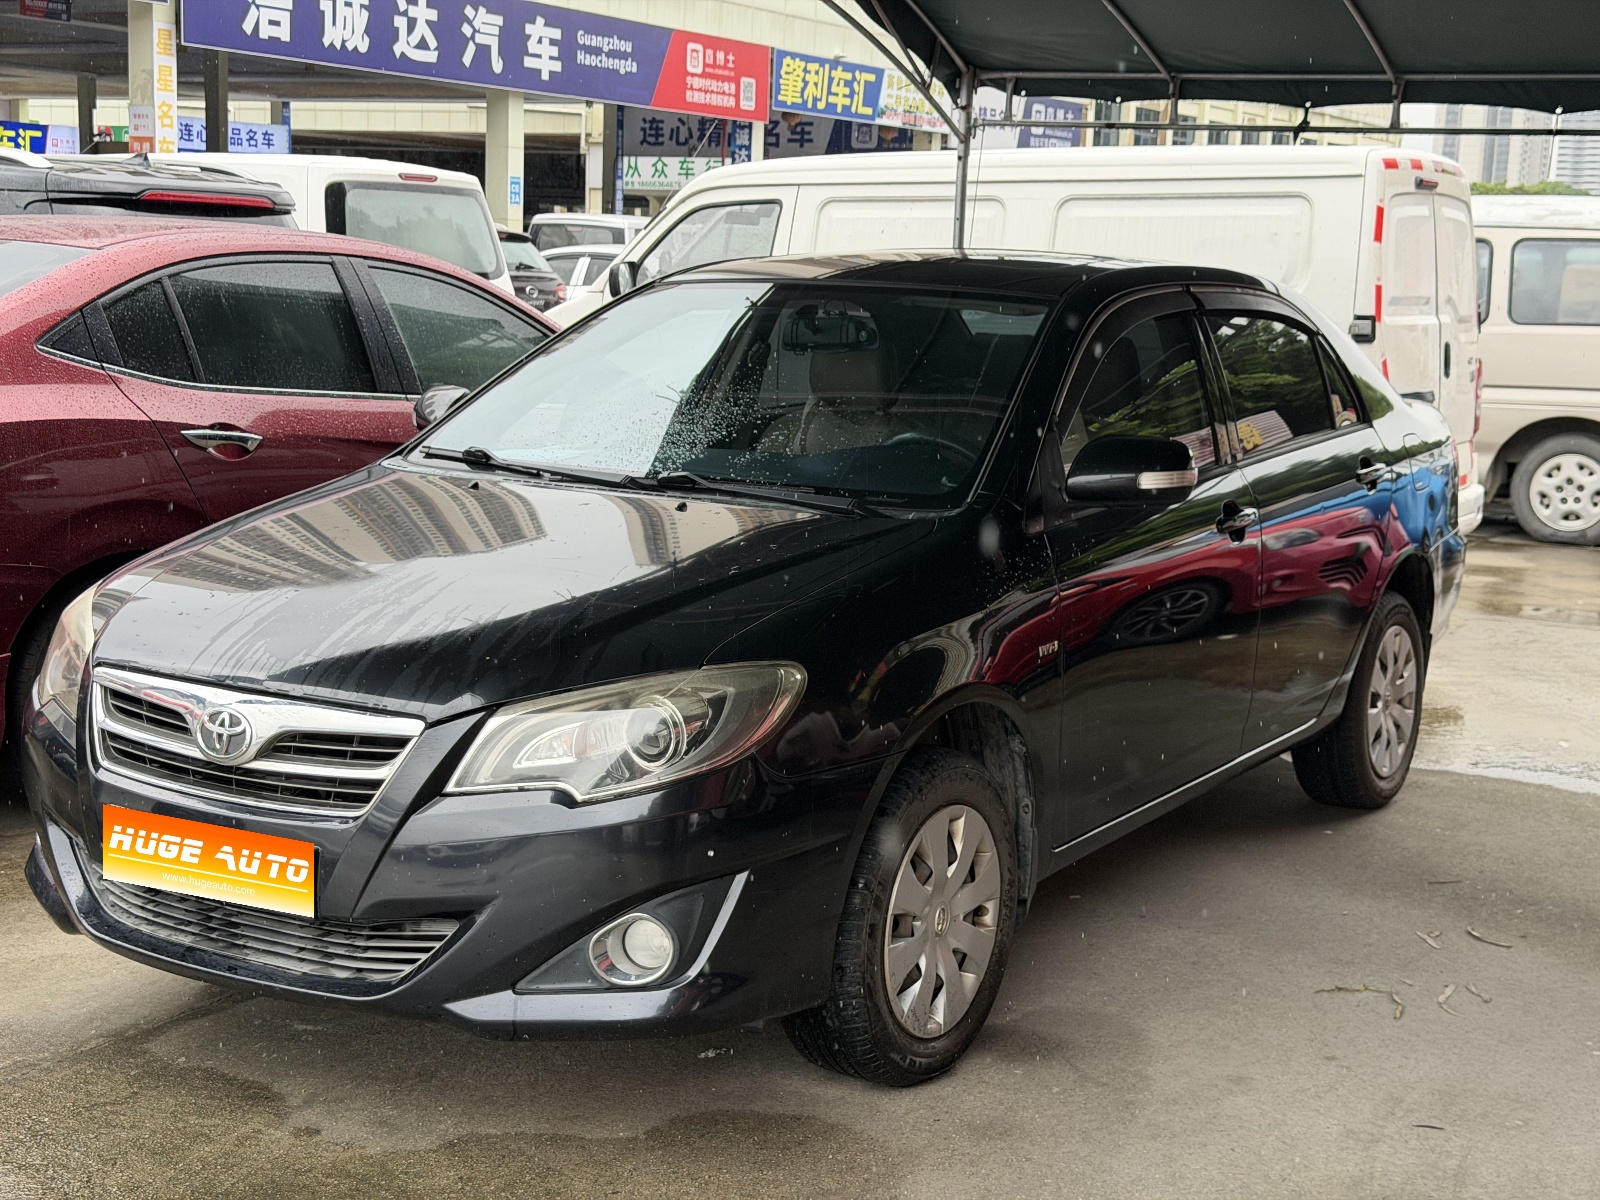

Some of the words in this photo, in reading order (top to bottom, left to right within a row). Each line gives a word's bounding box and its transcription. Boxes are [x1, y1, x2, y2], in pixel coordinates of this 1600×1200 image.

[577, 29, 632, 53] Guangzhou
[576, 50, 638, 74] Haochengda
[778, 55, 876, 116] 肇利车汇
